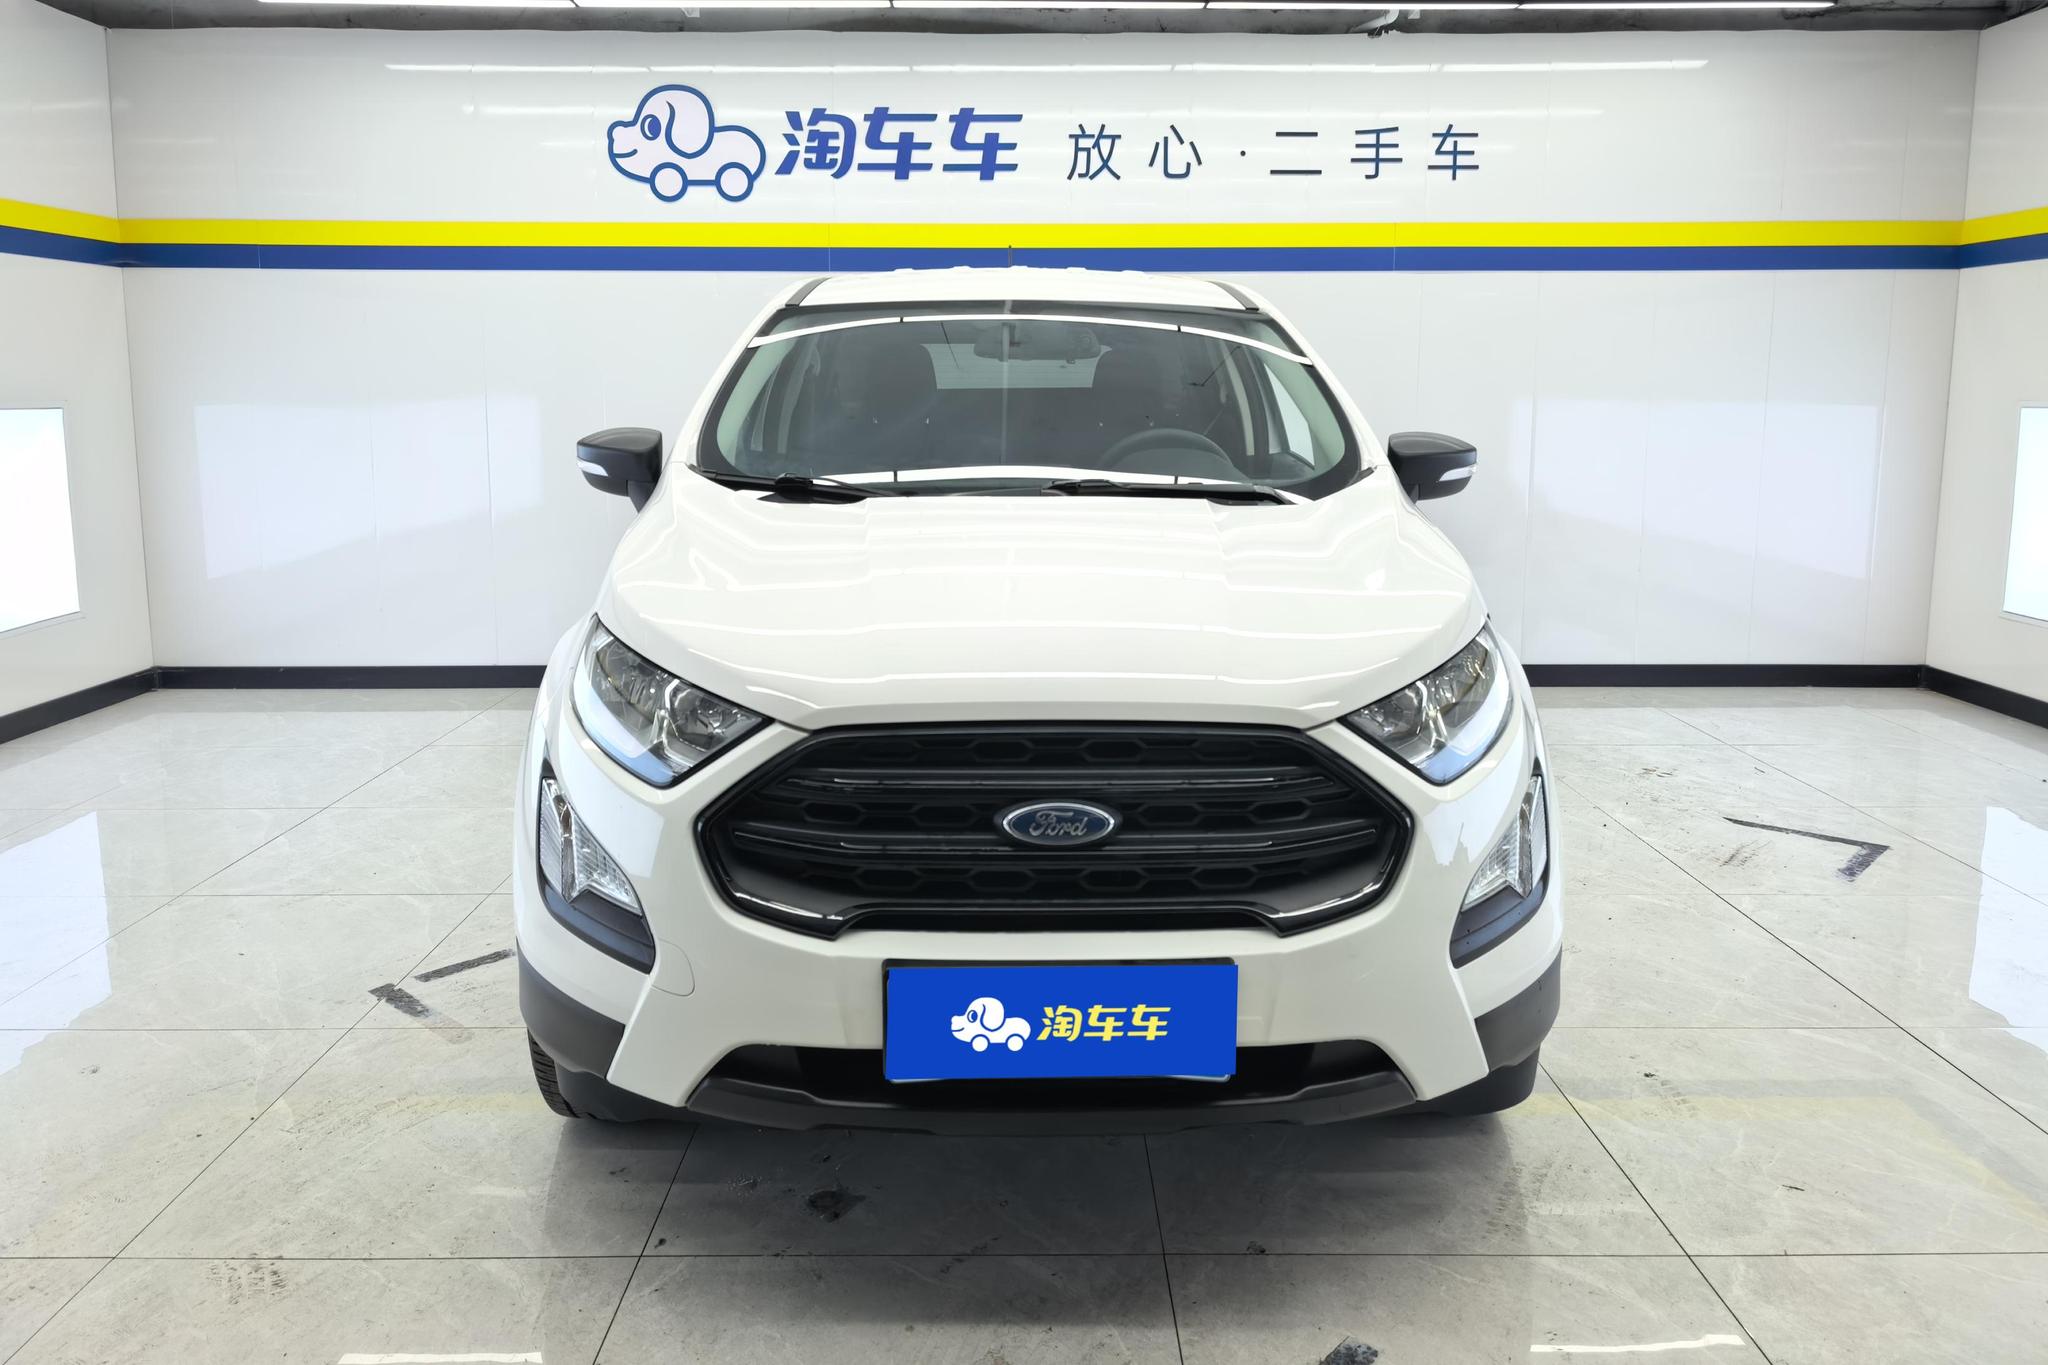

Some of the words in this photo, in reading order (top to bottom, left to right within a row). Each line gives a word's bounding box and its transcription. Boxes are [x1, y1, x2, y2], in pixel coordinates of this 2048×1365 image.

[774, 106, 1024, 181] 淘车车
[1029, 810, 1088, 836] Ford
